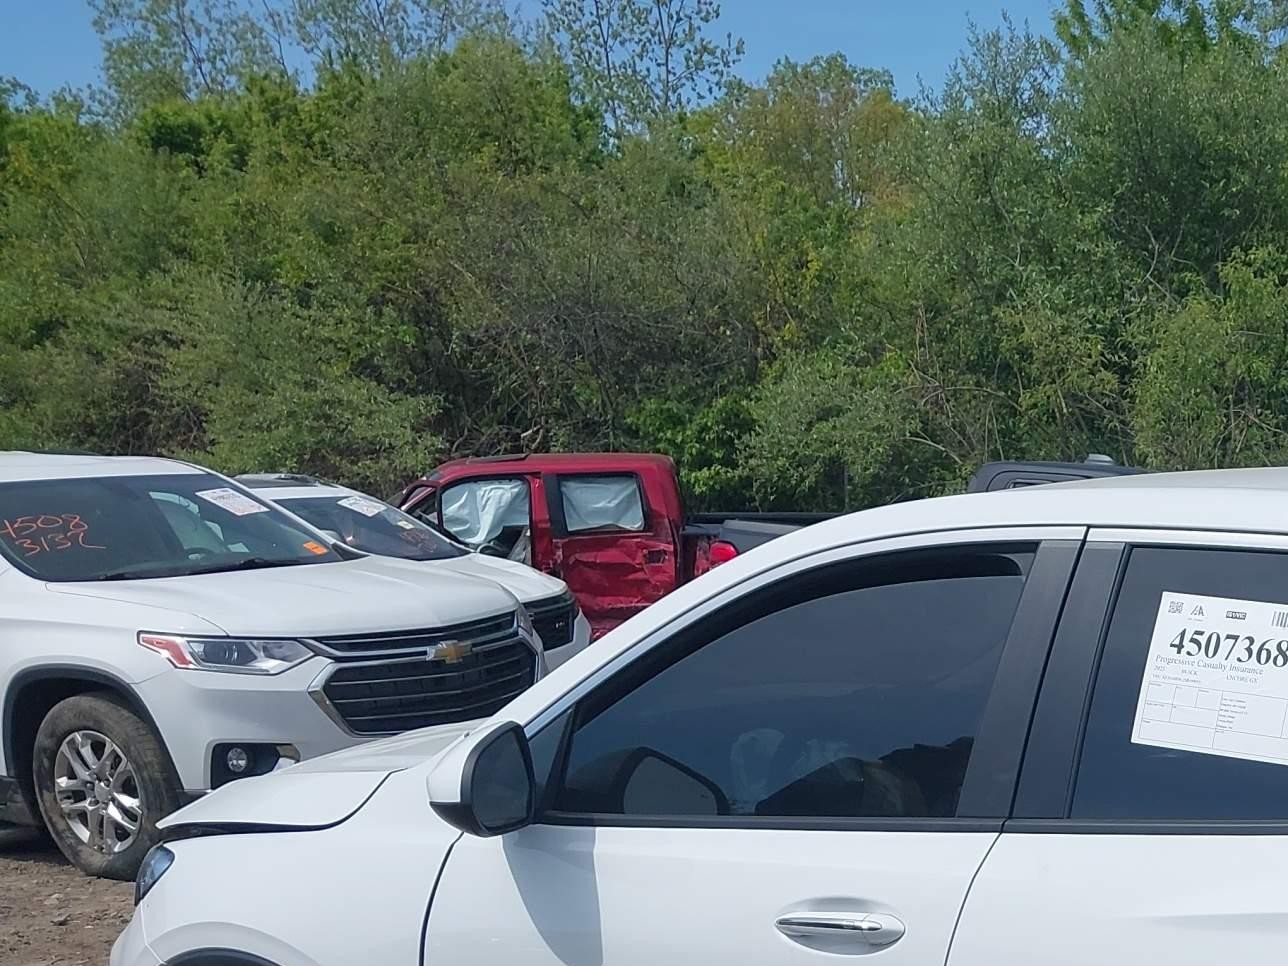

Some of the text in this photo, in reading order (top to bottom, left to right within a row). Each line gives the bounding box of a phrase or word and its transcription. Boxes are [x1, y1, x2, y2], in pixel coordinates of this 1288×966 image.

[1155, 654, 1264, 676] Progressive Casualty Insurance
